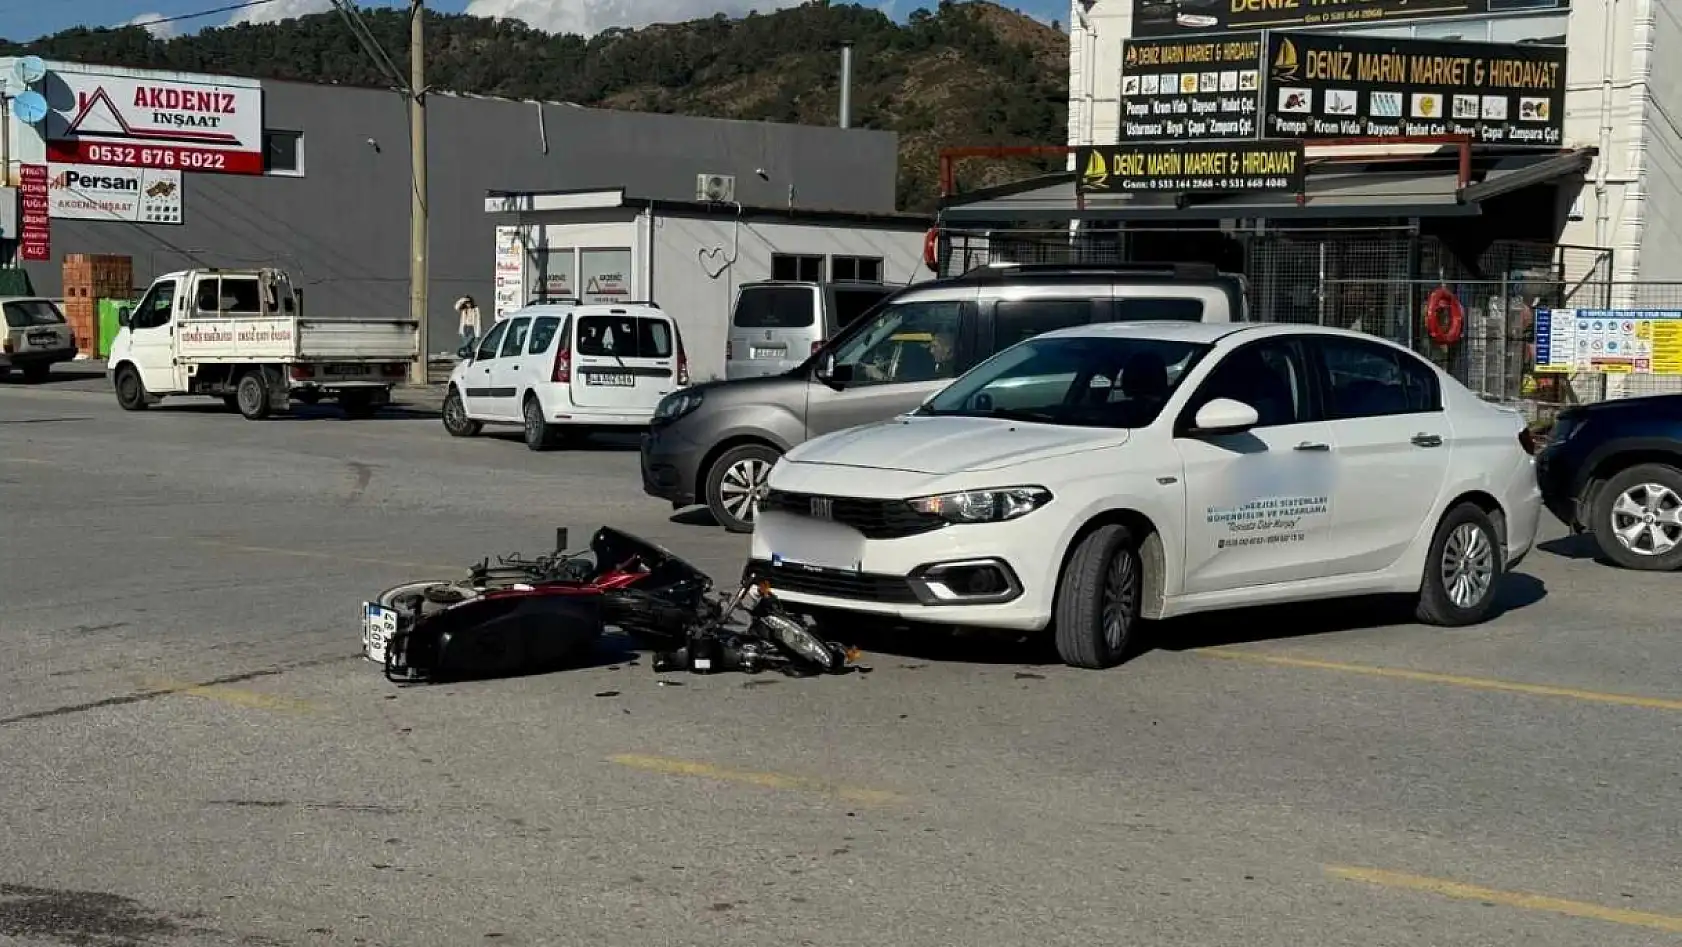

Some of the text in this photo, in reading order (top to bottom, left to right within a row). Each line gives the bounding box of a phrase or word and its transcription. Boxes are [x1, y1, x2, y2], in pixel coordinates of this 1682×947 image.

[1306, 44, 1559, 89] DENİZ MARİN MARKET & HIRDAVAT
[133, 87, 236, 114] AKDENİZ
[1276, 118, 1307, 138] Pompa
[1314, 118, 1339, 134] Krom
[1340, 119, 1361, 135] Vida
[1367, 121, 1399, 137] Dayson
[1405, 122, 1429, 136] Halat
[1481, 126, 1504, 142] Çapa
[89, 147, 225, 169] 0532 676 5022
[1113, 149, 1298, 176] DENİZ MARİN MARKET & HIRDAVAT
[66, 170, 138, 190] Persan
[1150, 180, 1157, 188] 0
[1229, 179, 1245, 188] 531
